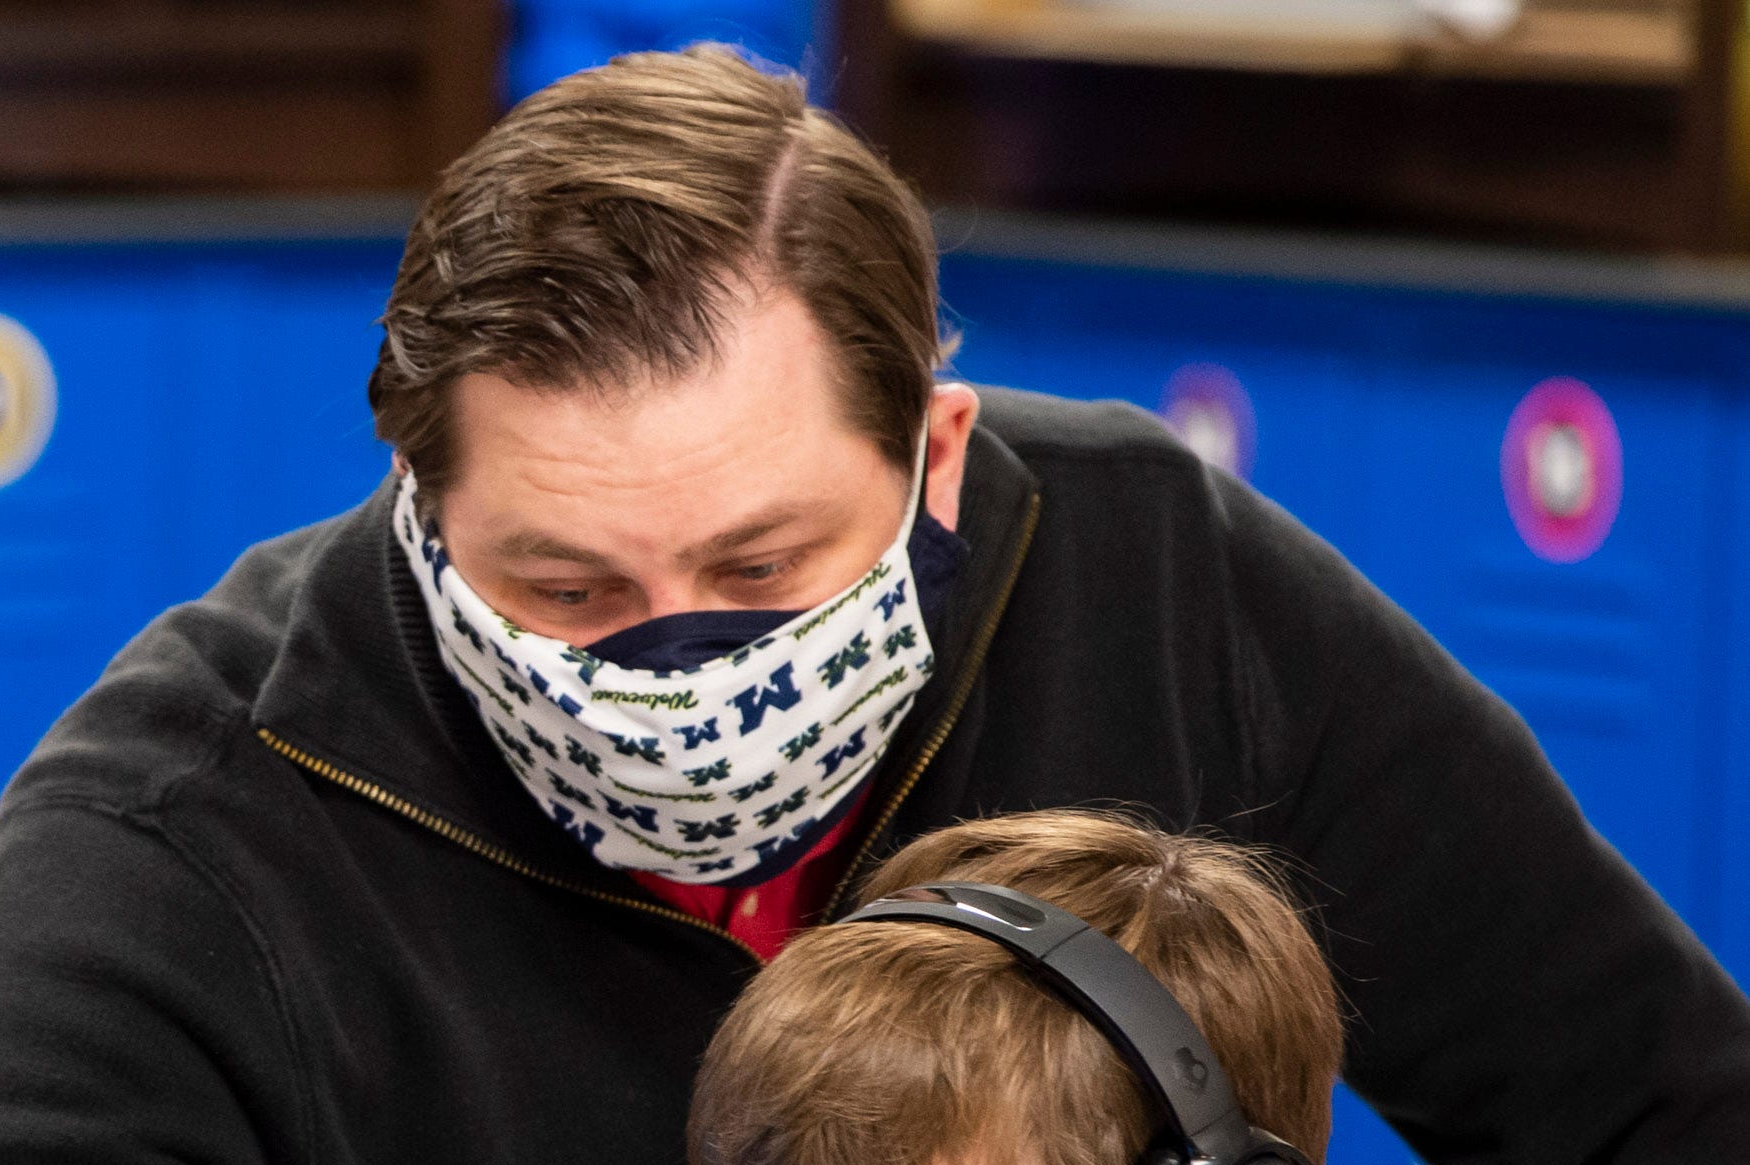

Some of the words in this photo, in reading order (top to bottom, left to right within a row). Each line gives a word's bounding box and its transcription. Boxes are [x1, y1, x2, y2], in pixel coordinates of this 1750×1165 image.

[817, 630, 871, 690] M
[732, 660, 803, 737] M
[677, 716, 721, 750] M
[815, 724, 867, 781] M
